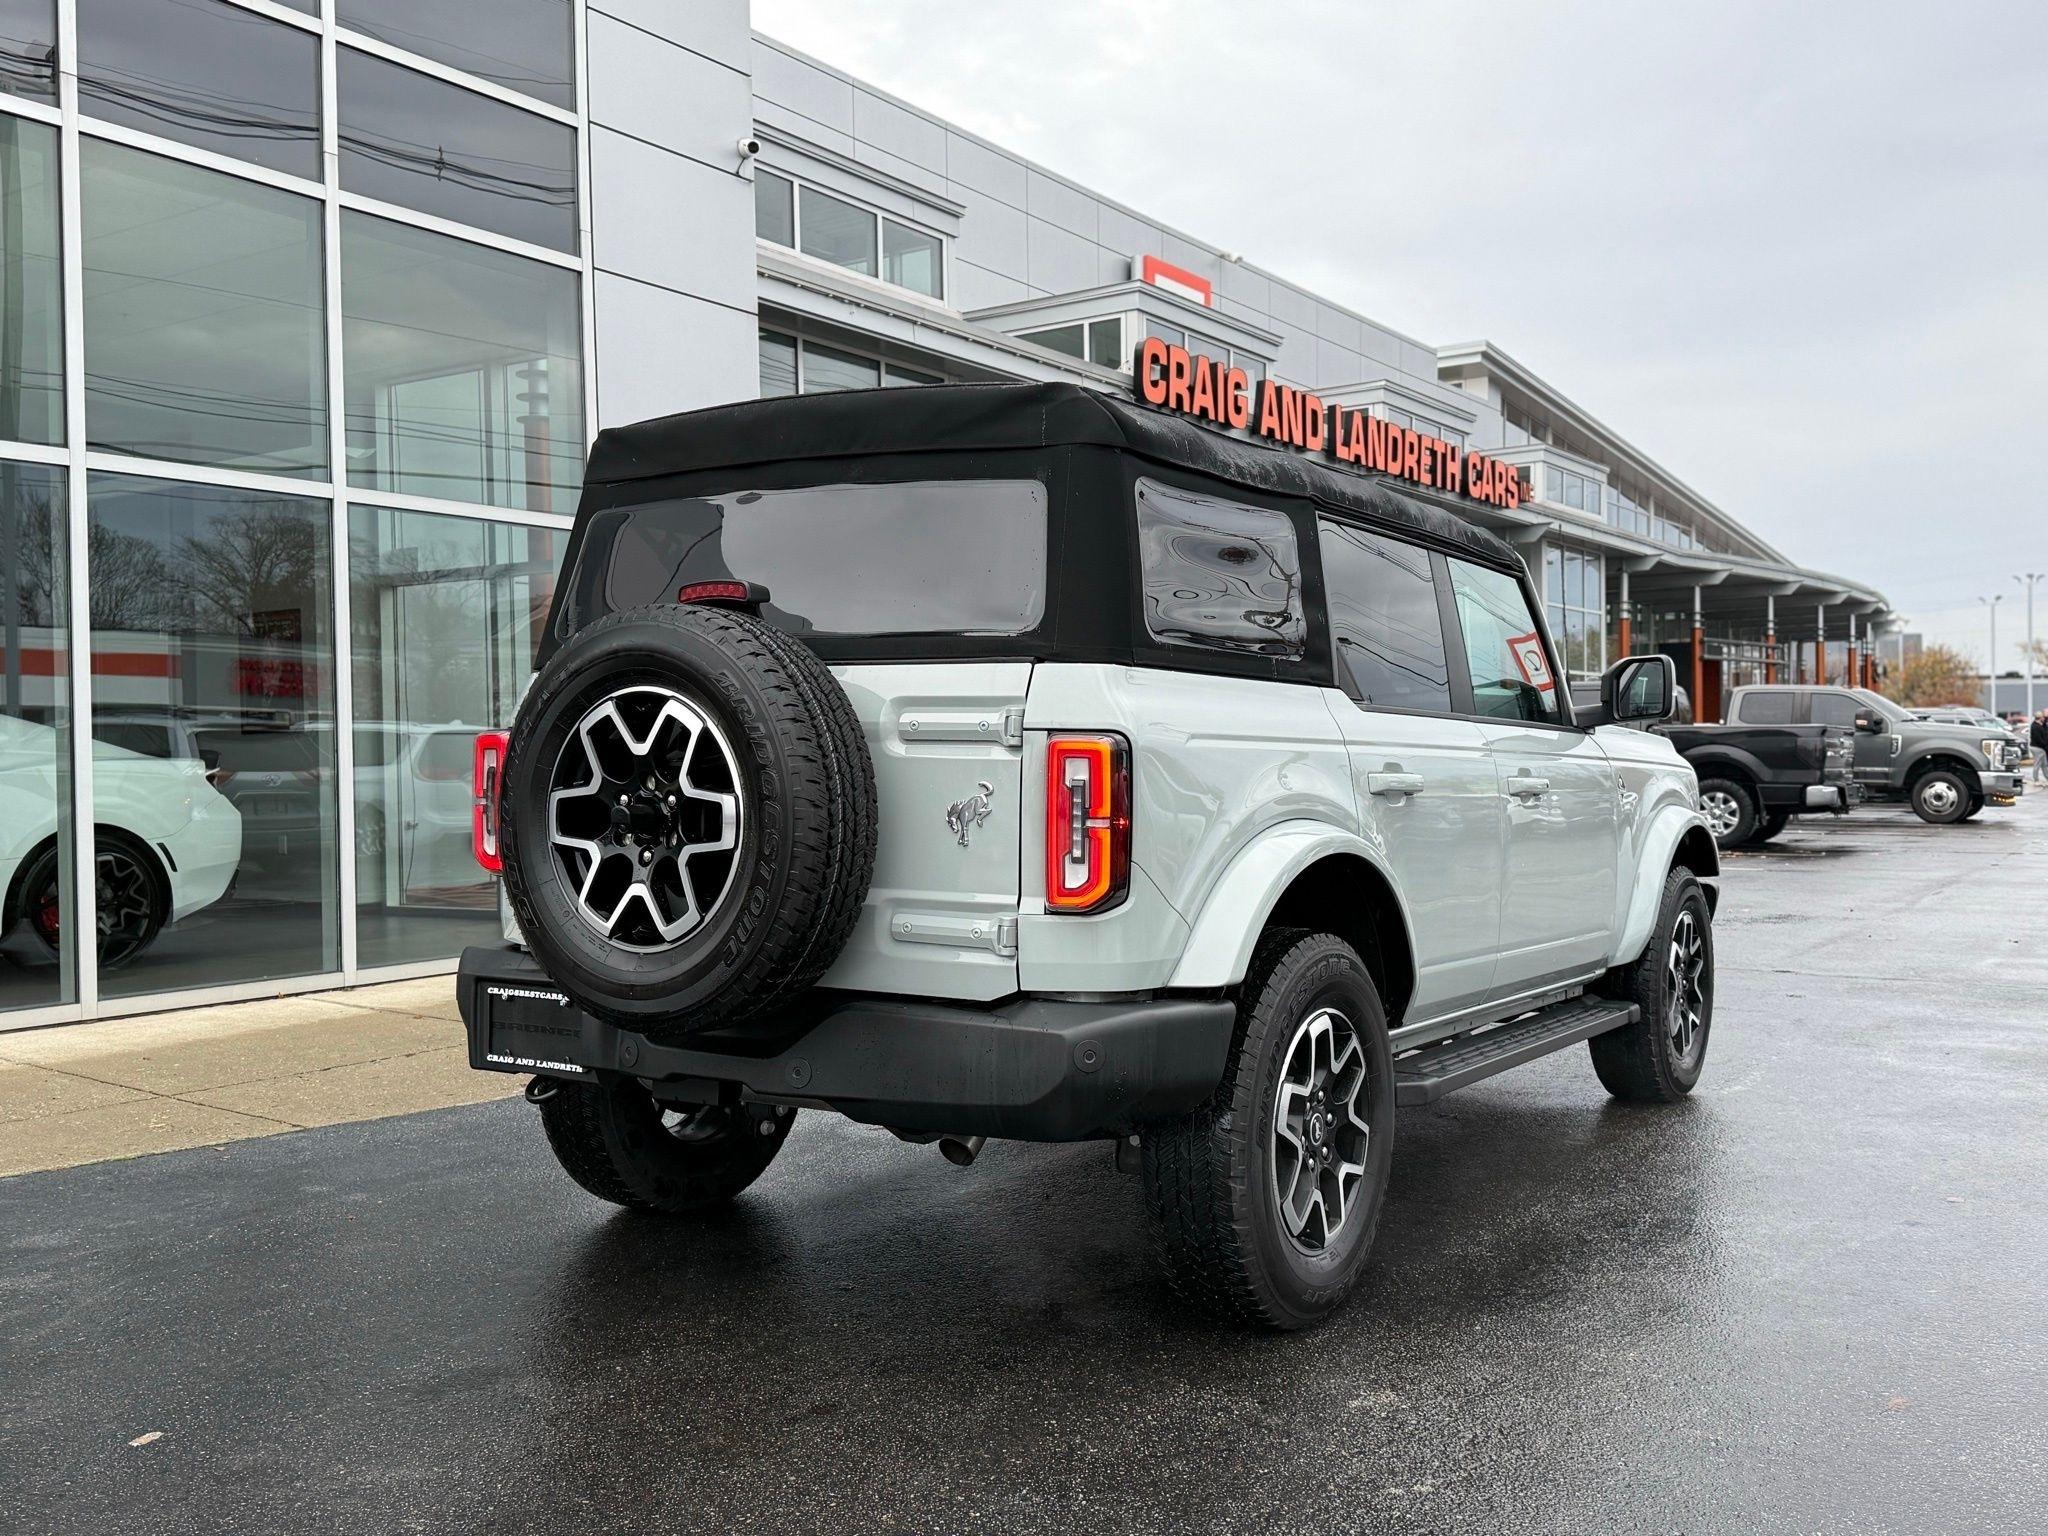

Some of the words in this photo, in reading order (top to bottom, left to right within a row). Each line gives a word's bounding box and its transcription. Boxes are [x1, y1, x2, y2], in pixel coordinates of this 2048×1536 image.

[1141, 336, 1249, 430] CRAIG
[1259, 378, 1325, 451] AND
[1335, 403, 1461, 493] LANDRETH
[1467, 450, 1519, 509] CARS
[486, 1054, 514, 1064] CRAIG
[515, 1057, 535, 1066] AND
